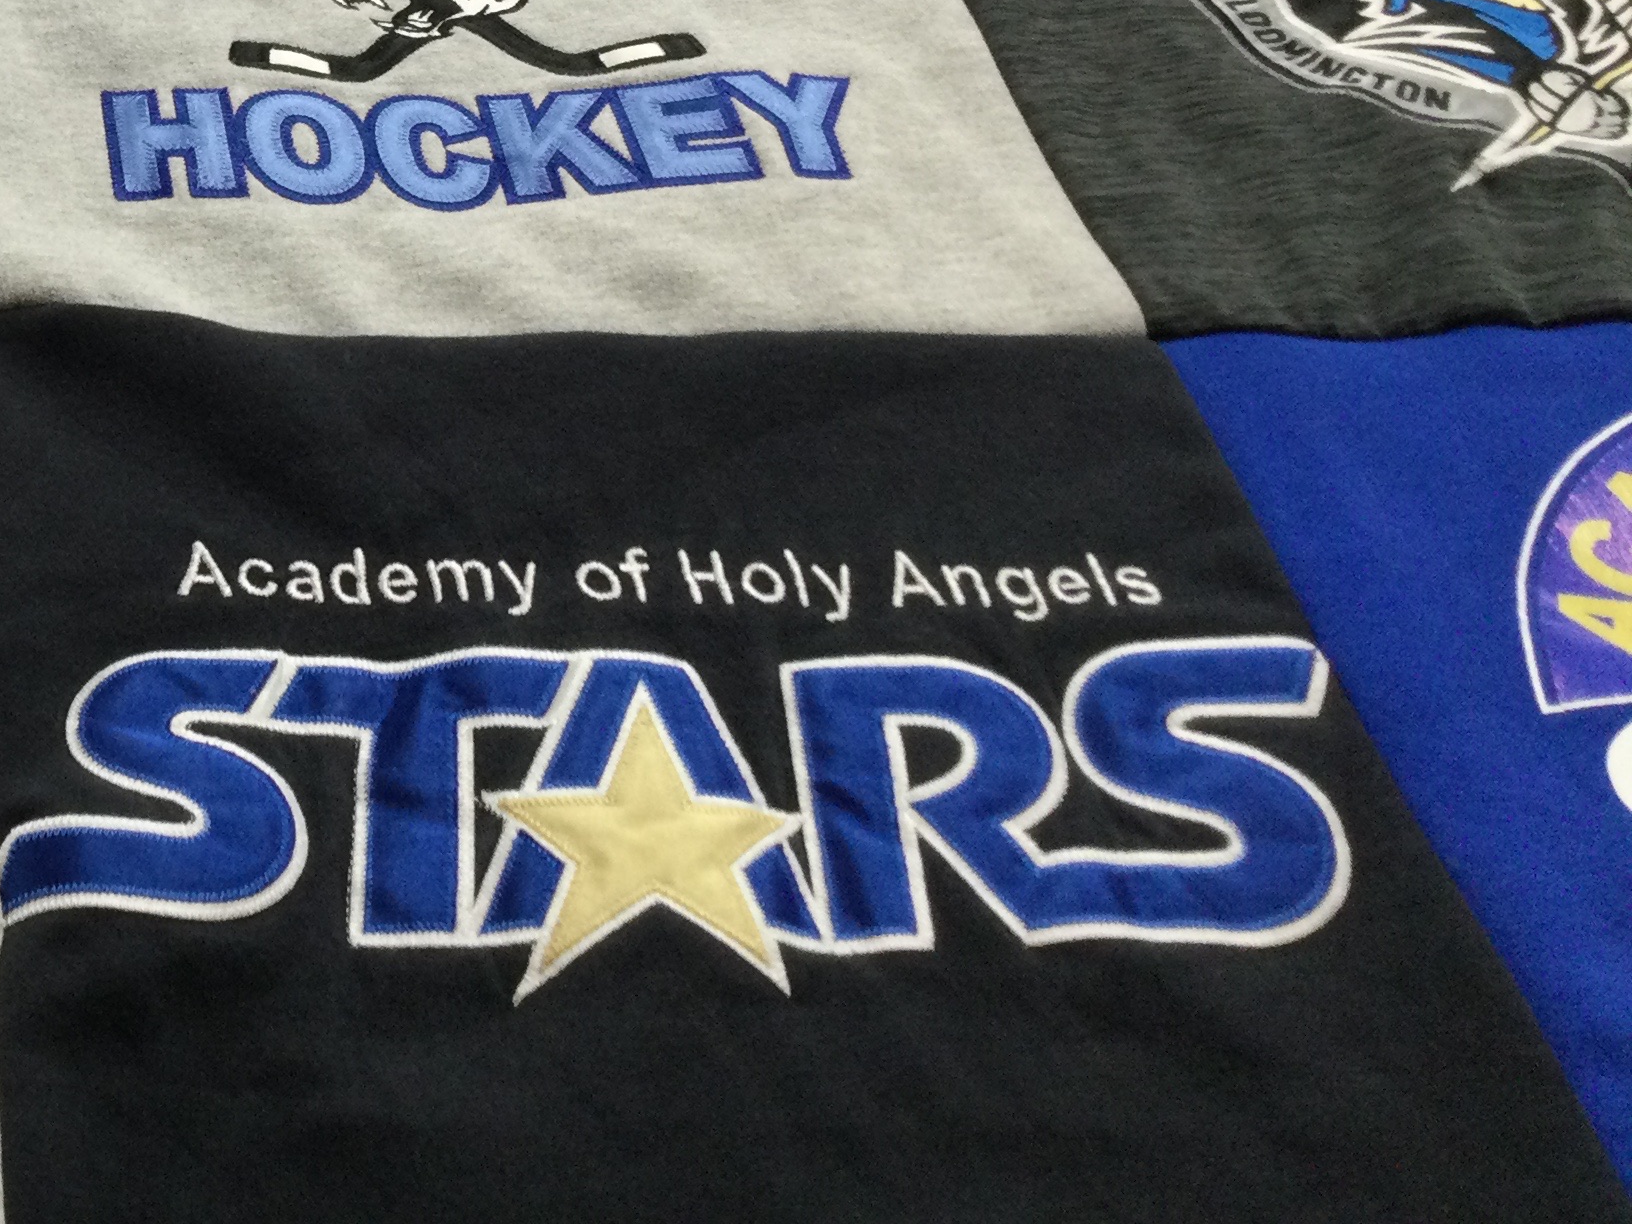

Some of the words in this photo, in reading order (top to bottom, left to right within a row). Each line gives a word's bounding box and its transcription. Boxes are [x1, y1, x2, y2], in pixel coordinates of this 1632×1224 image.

[101, 69, 854, 212] HOCKEY
[175, 538, 537, 617] Academy
[574, 546, 650, 608] of
[677, 546, 854, 621] Holy
[890, 548, 1164, 622] Angels
